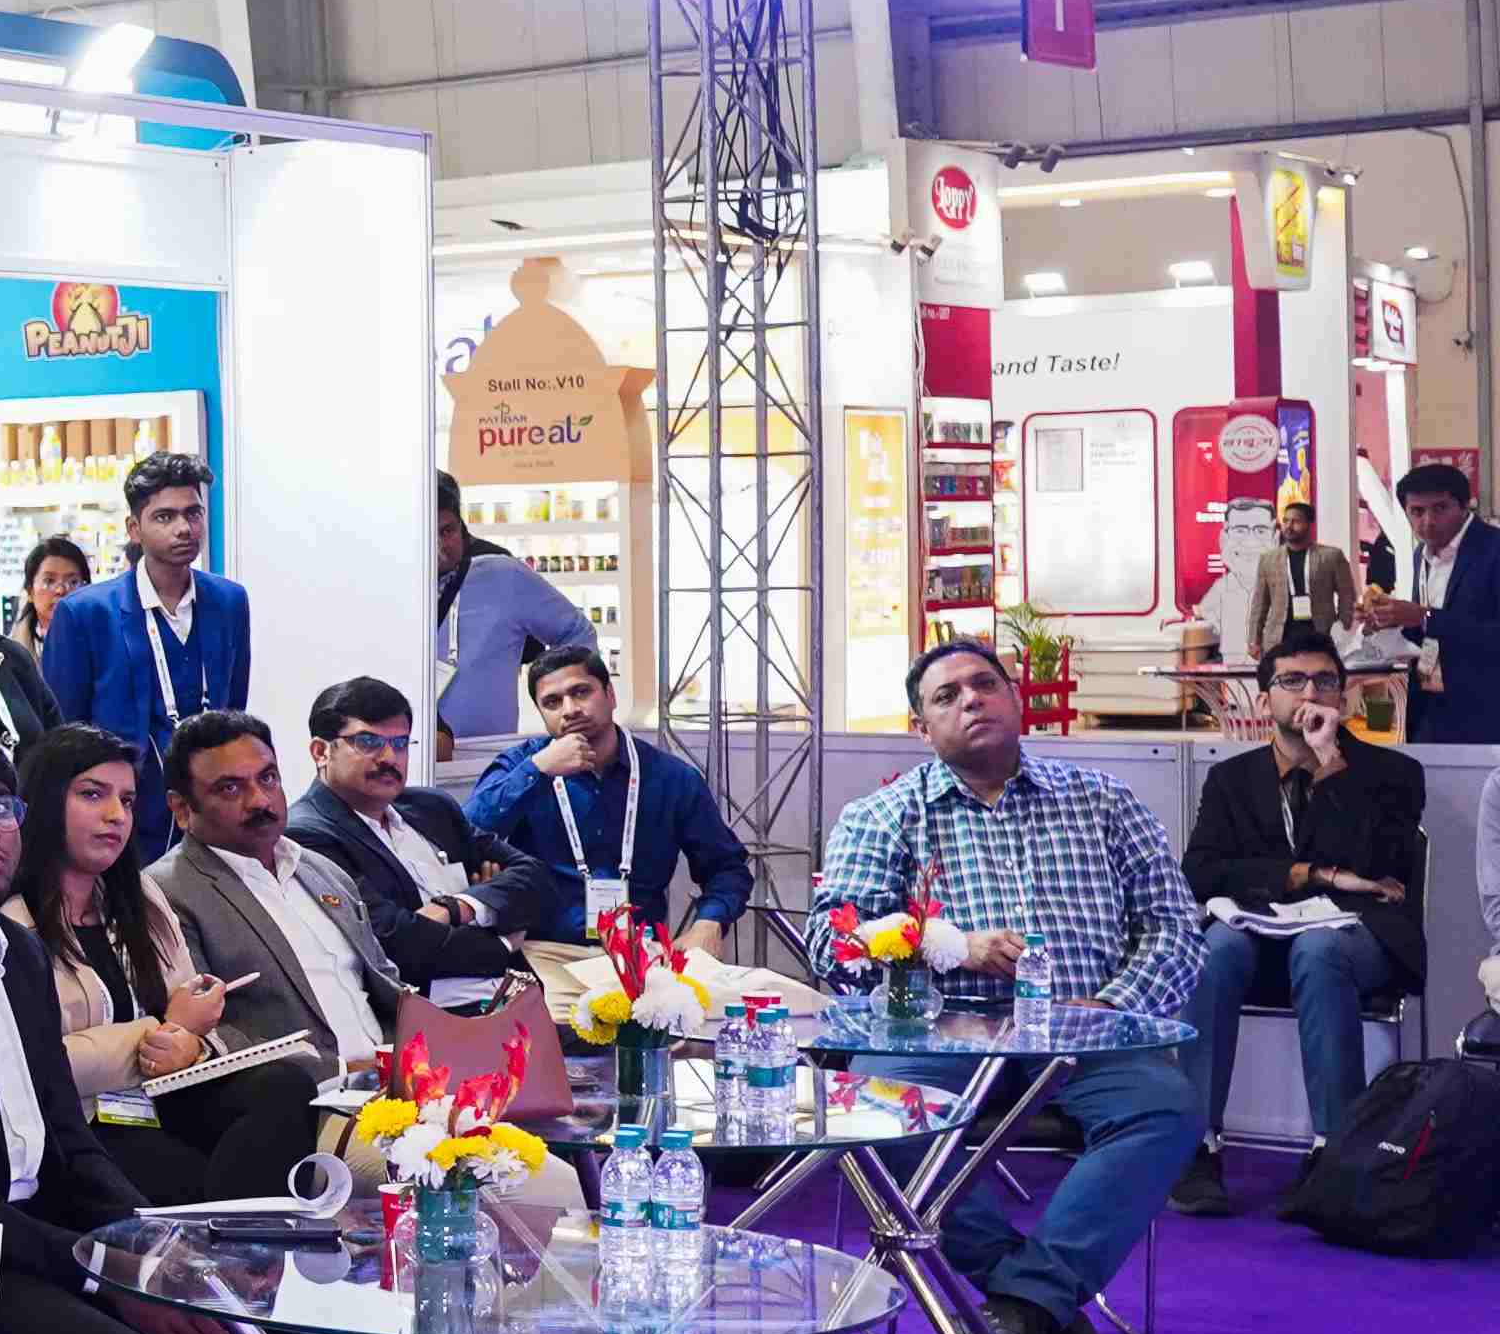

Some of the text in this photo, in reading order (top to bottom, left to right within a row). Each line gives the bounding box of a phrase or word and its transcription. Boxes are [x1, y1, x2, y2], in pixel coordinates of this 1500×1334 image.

[991, 352, 1121, 376] and Taste!
[487, 378, 521, 393] Stall
